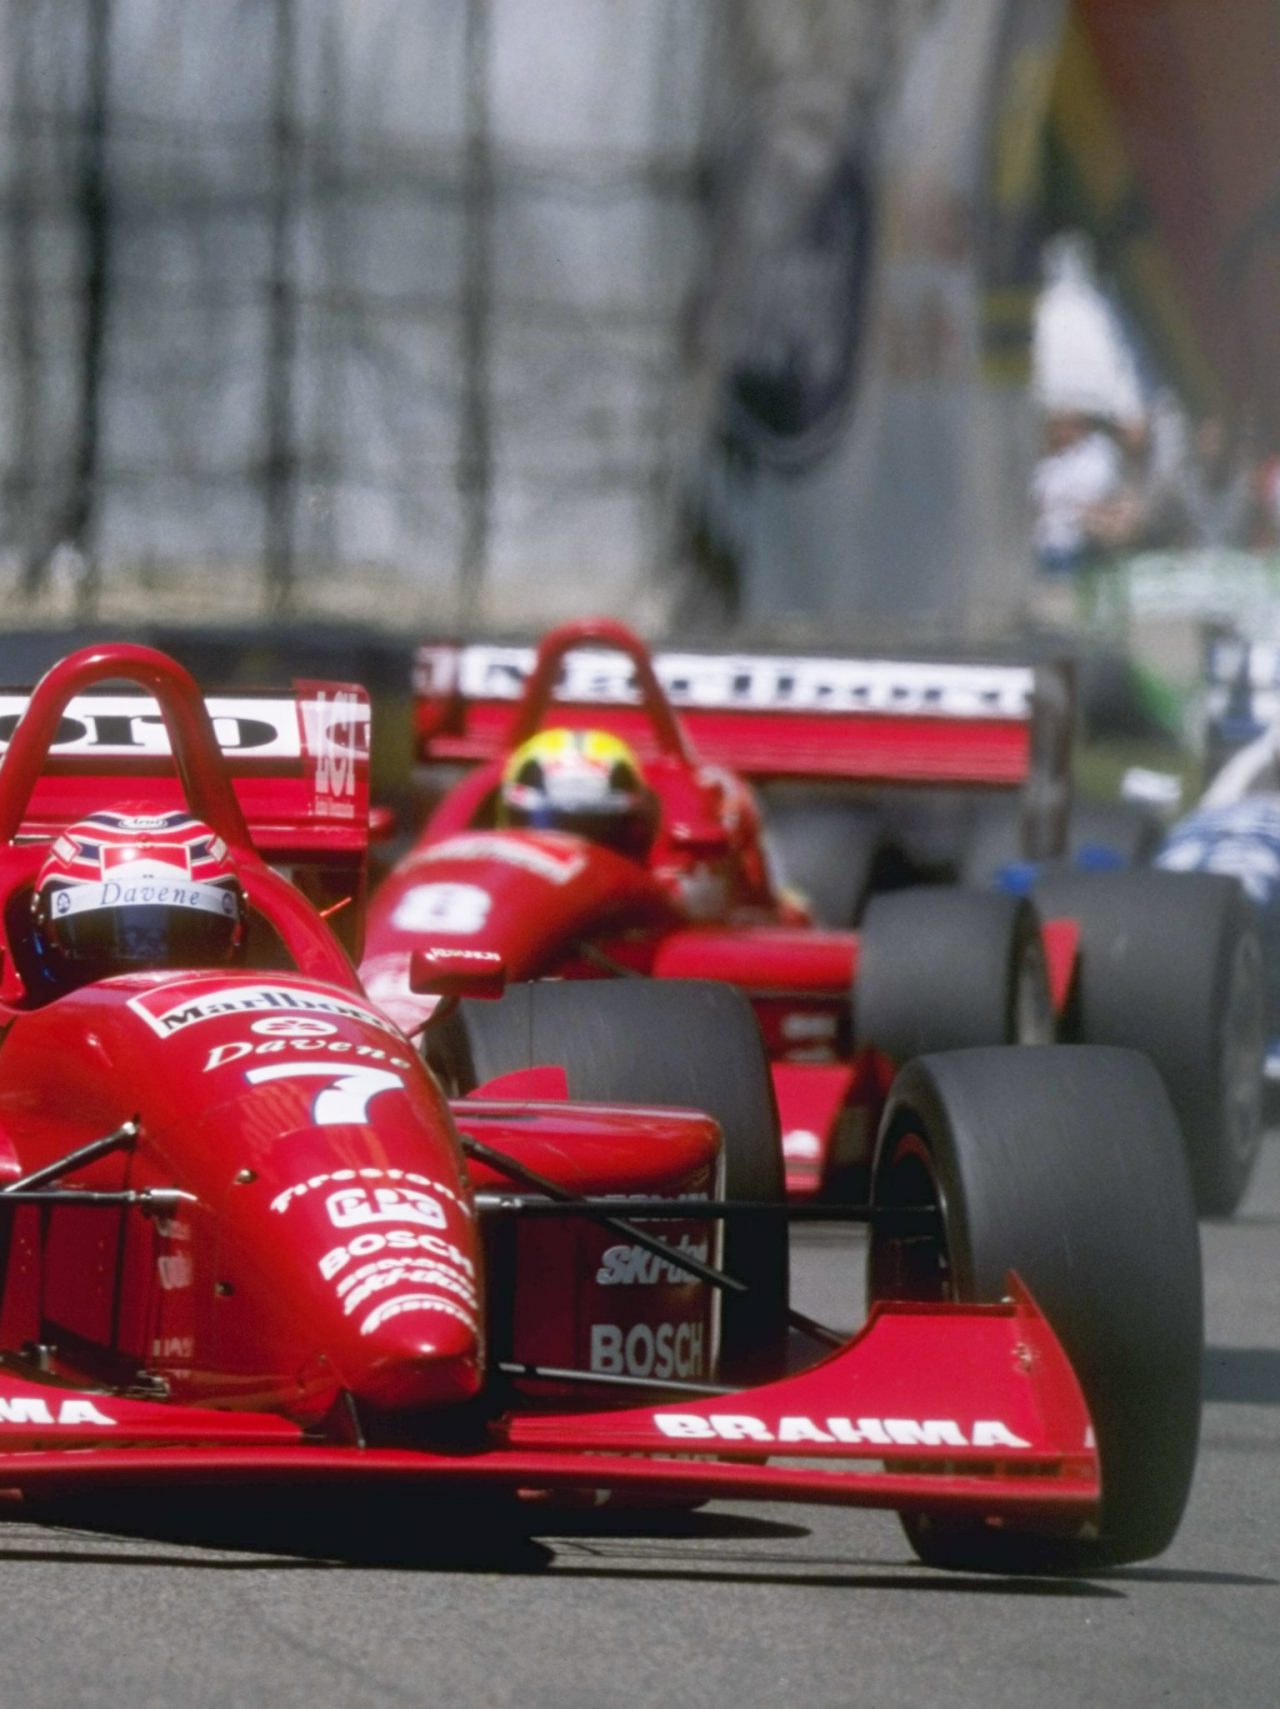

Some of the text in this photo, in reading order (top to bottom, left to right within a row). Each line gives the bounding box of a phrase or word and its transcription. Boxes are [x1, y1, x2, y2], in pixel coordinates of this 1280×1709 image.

[101, 880, 201, 906] Davene
[202, 1038, 411, 1073] Davene
[244, 1062, 405, 1125] 7
[590, 1322, 704, 1379] BOSCH
[654, 1413, 1033, 1448] BRAHMA
